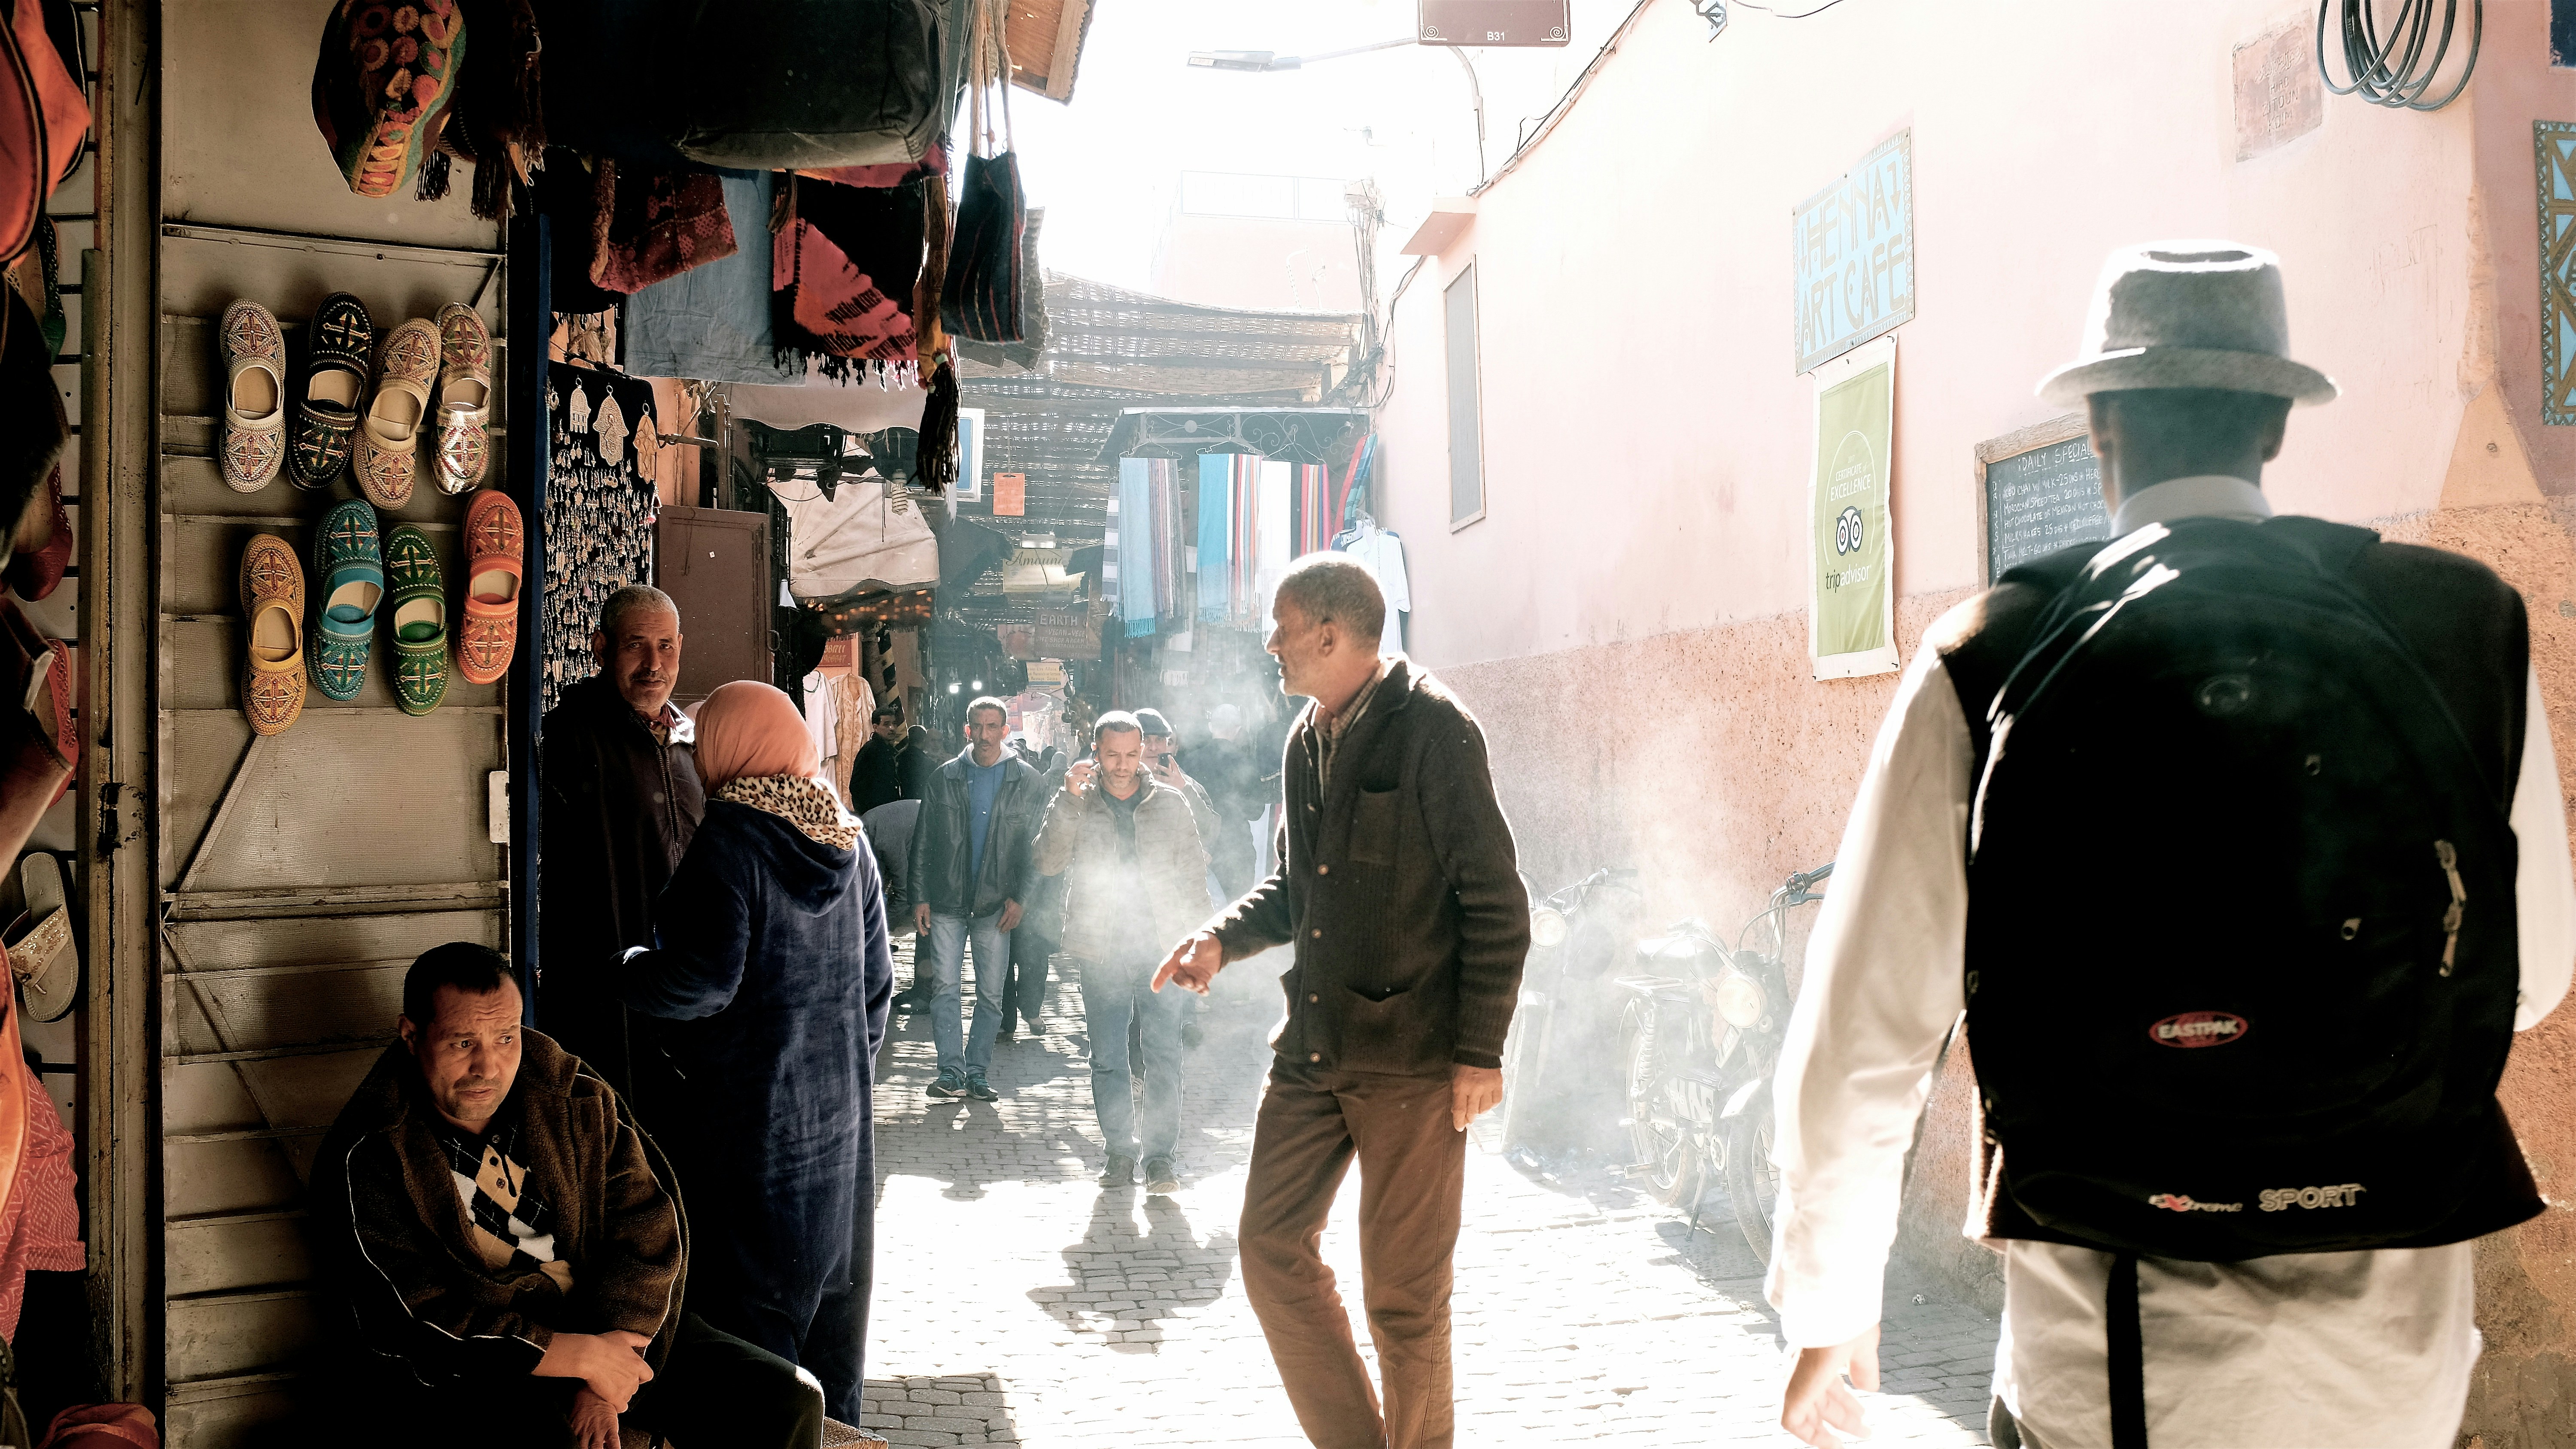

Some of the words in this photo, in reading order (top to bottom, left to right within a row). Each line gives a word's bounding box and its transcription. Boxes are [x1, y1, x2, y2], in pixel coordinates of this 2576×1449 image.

[1487, 31, 1504, 41] B31
[2262, 87, 2298, 116] ZITOUN
[1807, 165, 1890, 278] HENNA
[1800, 272, 1837, 352] ART
[1844, 234, 1905, 330] CAFE
[1835, 463, 1862, 481] CERTIFICATE
[1830, 473, 1871, 501] EXCELLENCE
[2017, 483, 2031, 496] CHAI
[2048, 494, 2060, 503] TEA
[2052, 504, 2076, 517] MEXICAN
[1040, 613, 1078, 627] EARTH
[2157, 1020, 2239, 1039] EASTPAK
[2258, 1183, 2366, 1212] SPORT
